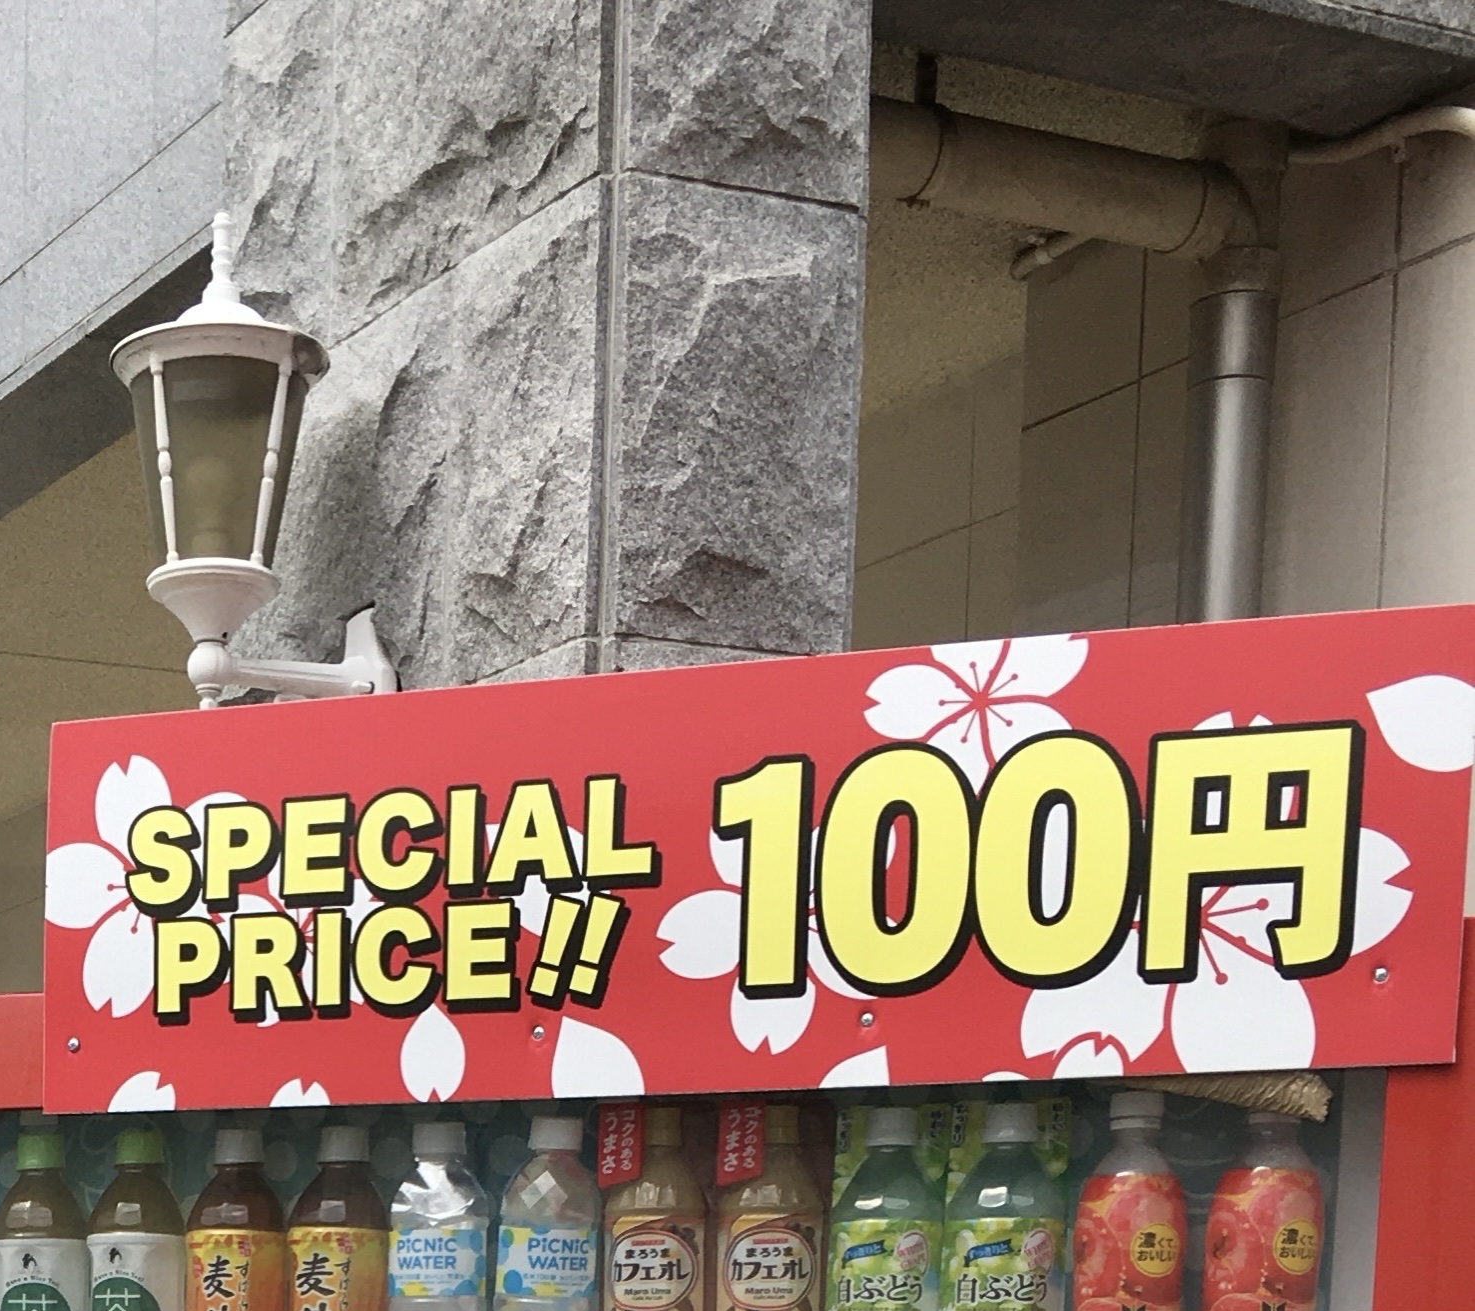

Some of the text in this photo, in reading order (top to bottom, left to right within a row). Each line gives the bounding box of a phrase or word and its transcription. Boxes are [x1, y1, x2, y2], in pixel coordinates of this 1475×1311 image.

[126, 772, 664, 918] SPECIAL
[715, 718, 1374, 1000] 100円
[156, 892, 628, 1026] PRICE!!
[601, 1112, 619, 1174] うまさ
[723, 1109, 741, 1172] うまさ
[396, 1255, 458, 1270] WATER
[527, 1255, 589, 1271] WATER
[624, 1247, 671, 1260] まろうま
[745, 1246, 793, 1258] まろうま
[612, 1258, 691, 1282] カフェオレ
[730, 1258, 809, 1282] カフェオレ
[837, 1274, 922, 1304] 白ぶどう
[956, 1273, 1048, 1304] 白ぶどう
